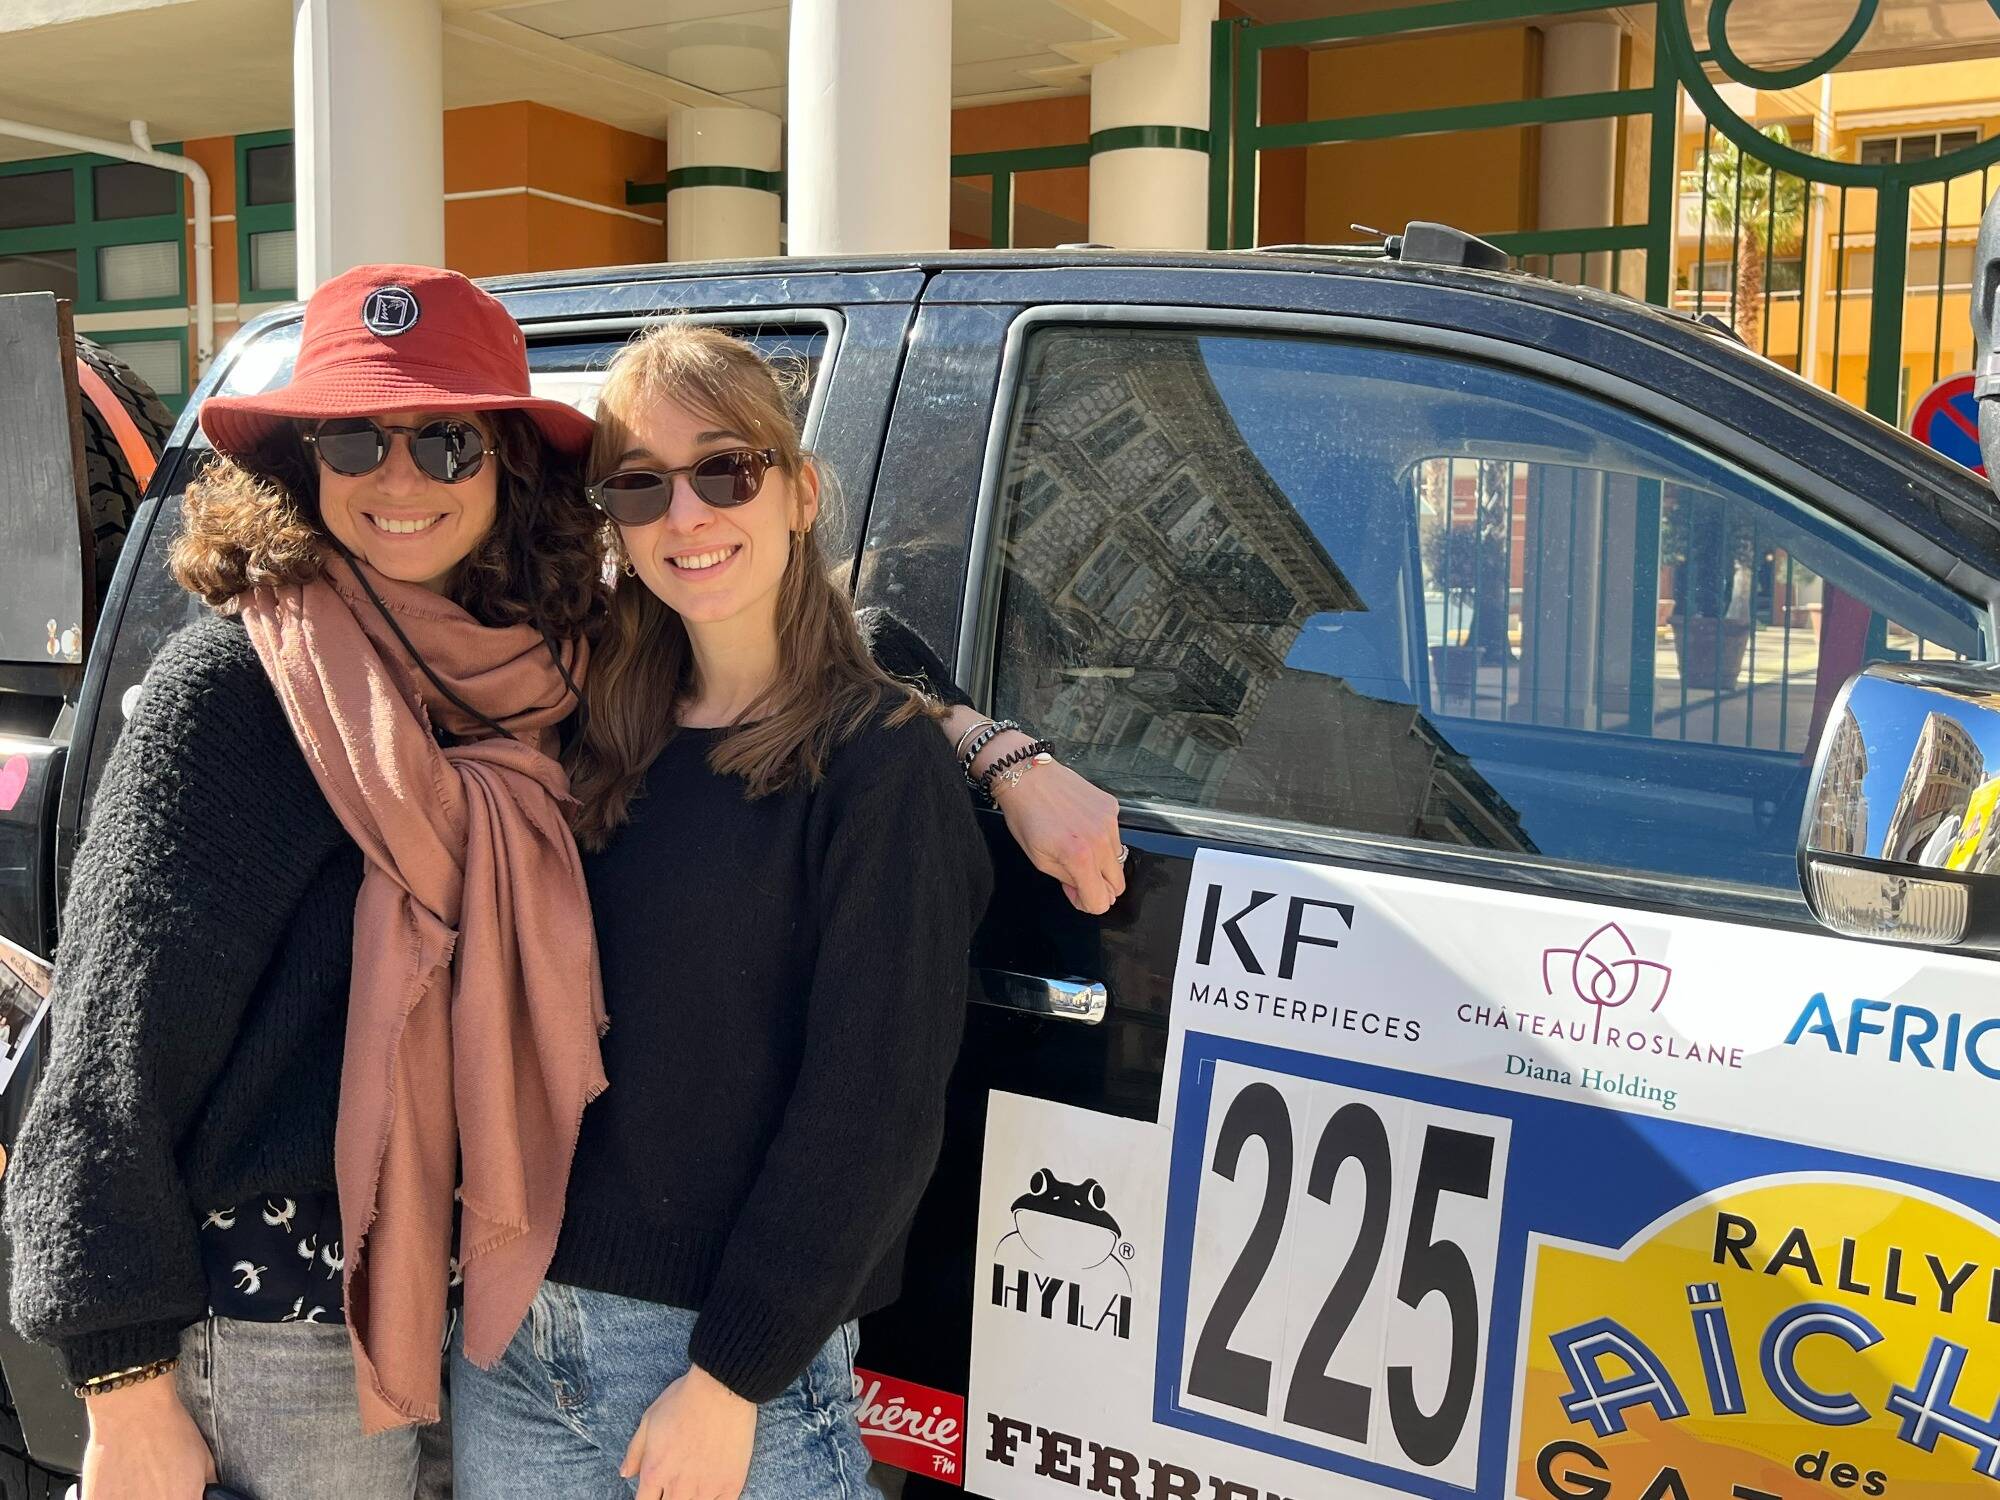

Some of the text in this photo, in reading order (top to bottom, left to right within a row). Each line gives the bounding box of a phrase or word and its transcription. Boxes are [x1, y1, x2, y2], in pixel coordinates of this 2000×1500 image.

[1196, 884, 1354, 980] KF
[1189, 982, 1422, 1042] MASTERPIECES
[1457, 1003, 1745, 1069] CHÂTEAU ROSLANE
[1504, 1054, 1678, 1111] Diana Holding
[991, 1263, 1132, 1340] HYLA
[1187, 1081, 1496, 1468] 225
[932, 1454, 956, 1474] FM
[1536, 1440, 1783, 1500] GA
[1793, 1450, 1888, 1497] des
